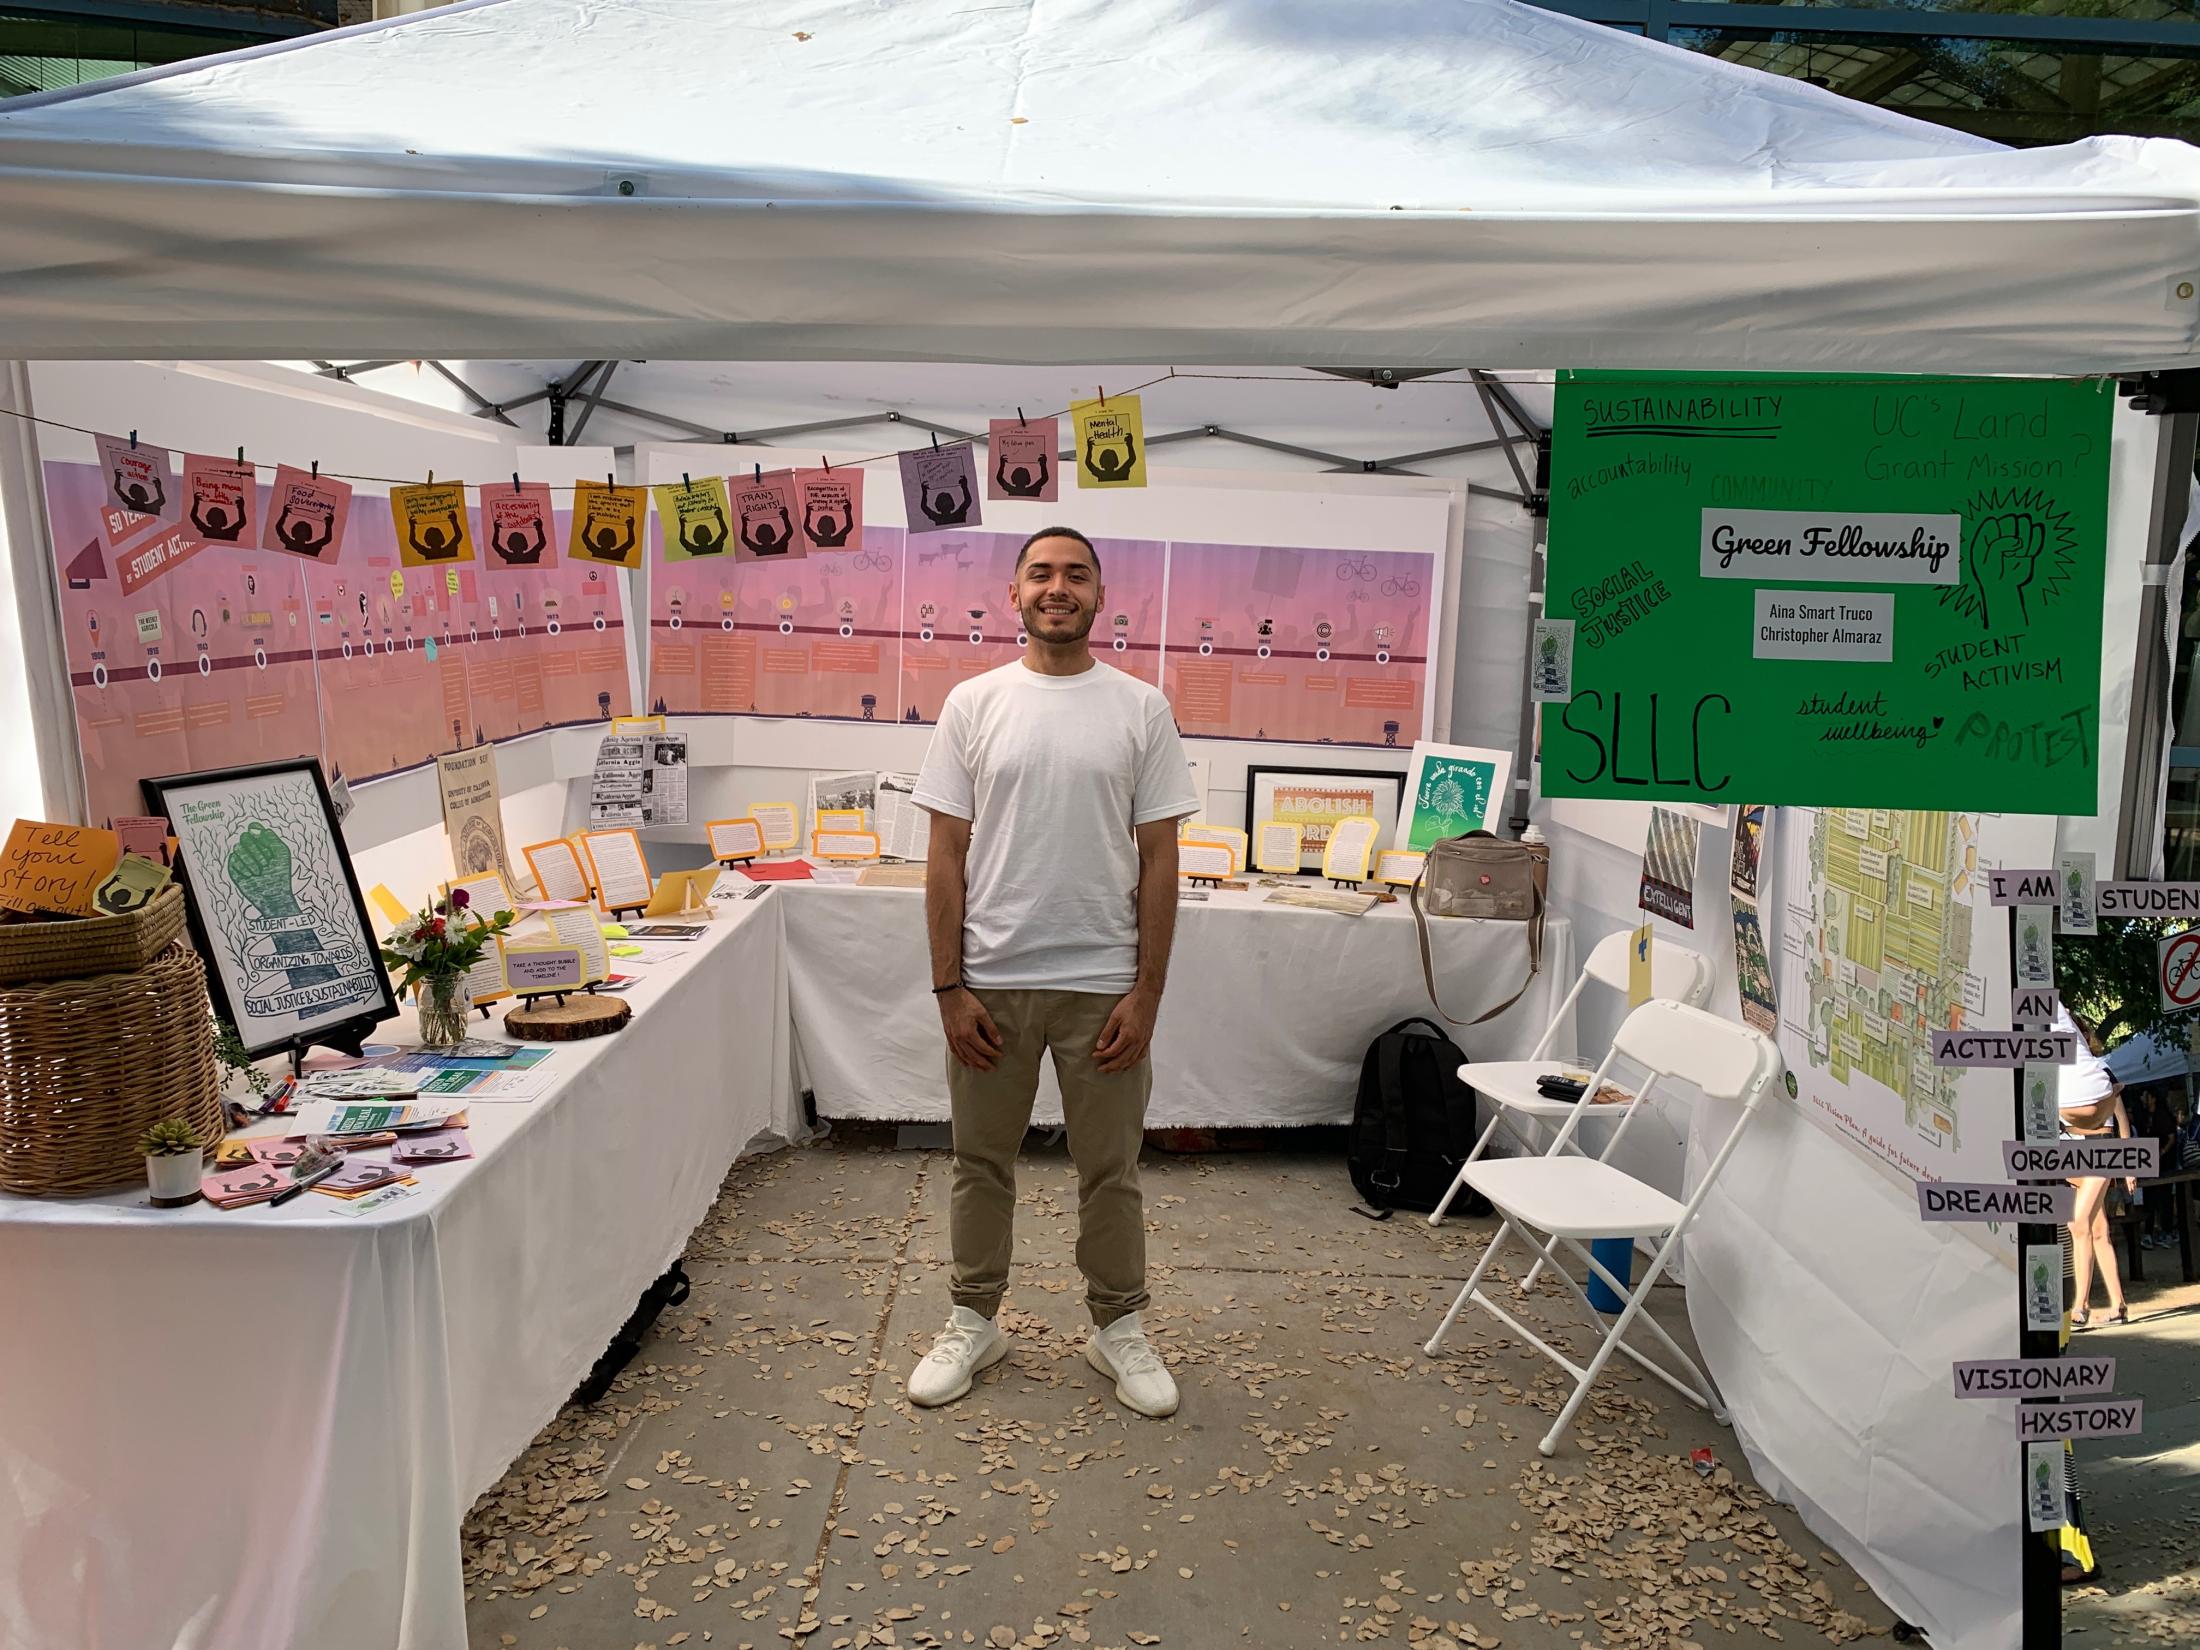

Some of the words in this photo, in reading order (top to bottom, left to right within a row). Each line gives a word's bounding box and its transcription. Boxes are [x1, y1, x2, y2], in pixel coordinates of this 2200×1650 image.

[1089, 415, 1118, 429] Mental
[1584, 395, 1783, 426] SUSTAINABILITY
[1873, 394, 1941, 438] UC's
[1953, 397, 2049, 440] Land
[1094, 426, 1123, 440] Health
[1865, 445, 1956, 481] Grant
[1967, 433, 2092, 481] Mission?
[1567, 451, 1693, 500] accountability
[1710, 474, 1834, 502] COMMUNITY
[292, 487, 316, 498] Food
[741, 491, 774, 503] TRANS
[745, 500, 780, 513] RIGHTS!
[131, 543, 167, 579] STUDENT
[1711, 524, 1792, 569] Green
[1799, 524, 1951, 574] Fellowship
[1571, 560, 1654, 619] SOCIAL
[1580, 580, 1672, 649] JUSTICE
[1769, 604, 1795, 619] Aina
[1799, 604, 1836, 621] Smart
[1839, 605, 1873, 621] Truco
[1760, 626, 1829, 645] Christopher
[1832, 628, 1883, 644] Almaraz
[1924, 633, 2027, 680] STUDENT
[1962, 657, 2064, 692] ACTIVISM
[1796, 691, 1888, 717] student
[1562, 689, 1732, 792] SLLC
[1819, 717, 1938, 749] wellbeing
[1954, 704, 2093, 769] PROTEST
[444, 758, 476, 771] FOUNDATION
[179, 803, 197, 814] The
[198, 800, 222, 812] Green
[182, 809, 225, 825] Fellowship
[1280, 796, 1367, 815] ABOLISH
[24, 826, 81, 848] Tell
[11, 848, 86, 871] your
[1992, 878, 2008, 898] I
[2017, 875, 2056, 898] AM
[1644, 885, 1693, 921] EXTELLIGENT
[2101, 888, 2200, 911] STUDEN
[253, 953, 310, 970] ORGANIZING
[311, 946, 353, 965] TOWARDS
[246, 999, 276, 1014] SOCIAL
[2016, 994, 2054, 1018] AN
[1939, 1037, 2072, 1060] ACTIVIST
[1825, 1102, 1843, 1121] Vision
[1862, 1127, 1868, 1138] A
[1869, 1134, 1886, 1150] guide
[1887, 1144, 1897, 1158] for
[1899, 1152, 1919, 1173] future
[2010, 1147, 2153, 1172] ORGANIZER
[1925, 1189, 2055, 1216] DREAMER
[1958, 1362, 2110, 1392] VISIONARY
[2021, 1406, 2137, 1436] HXSTORY
